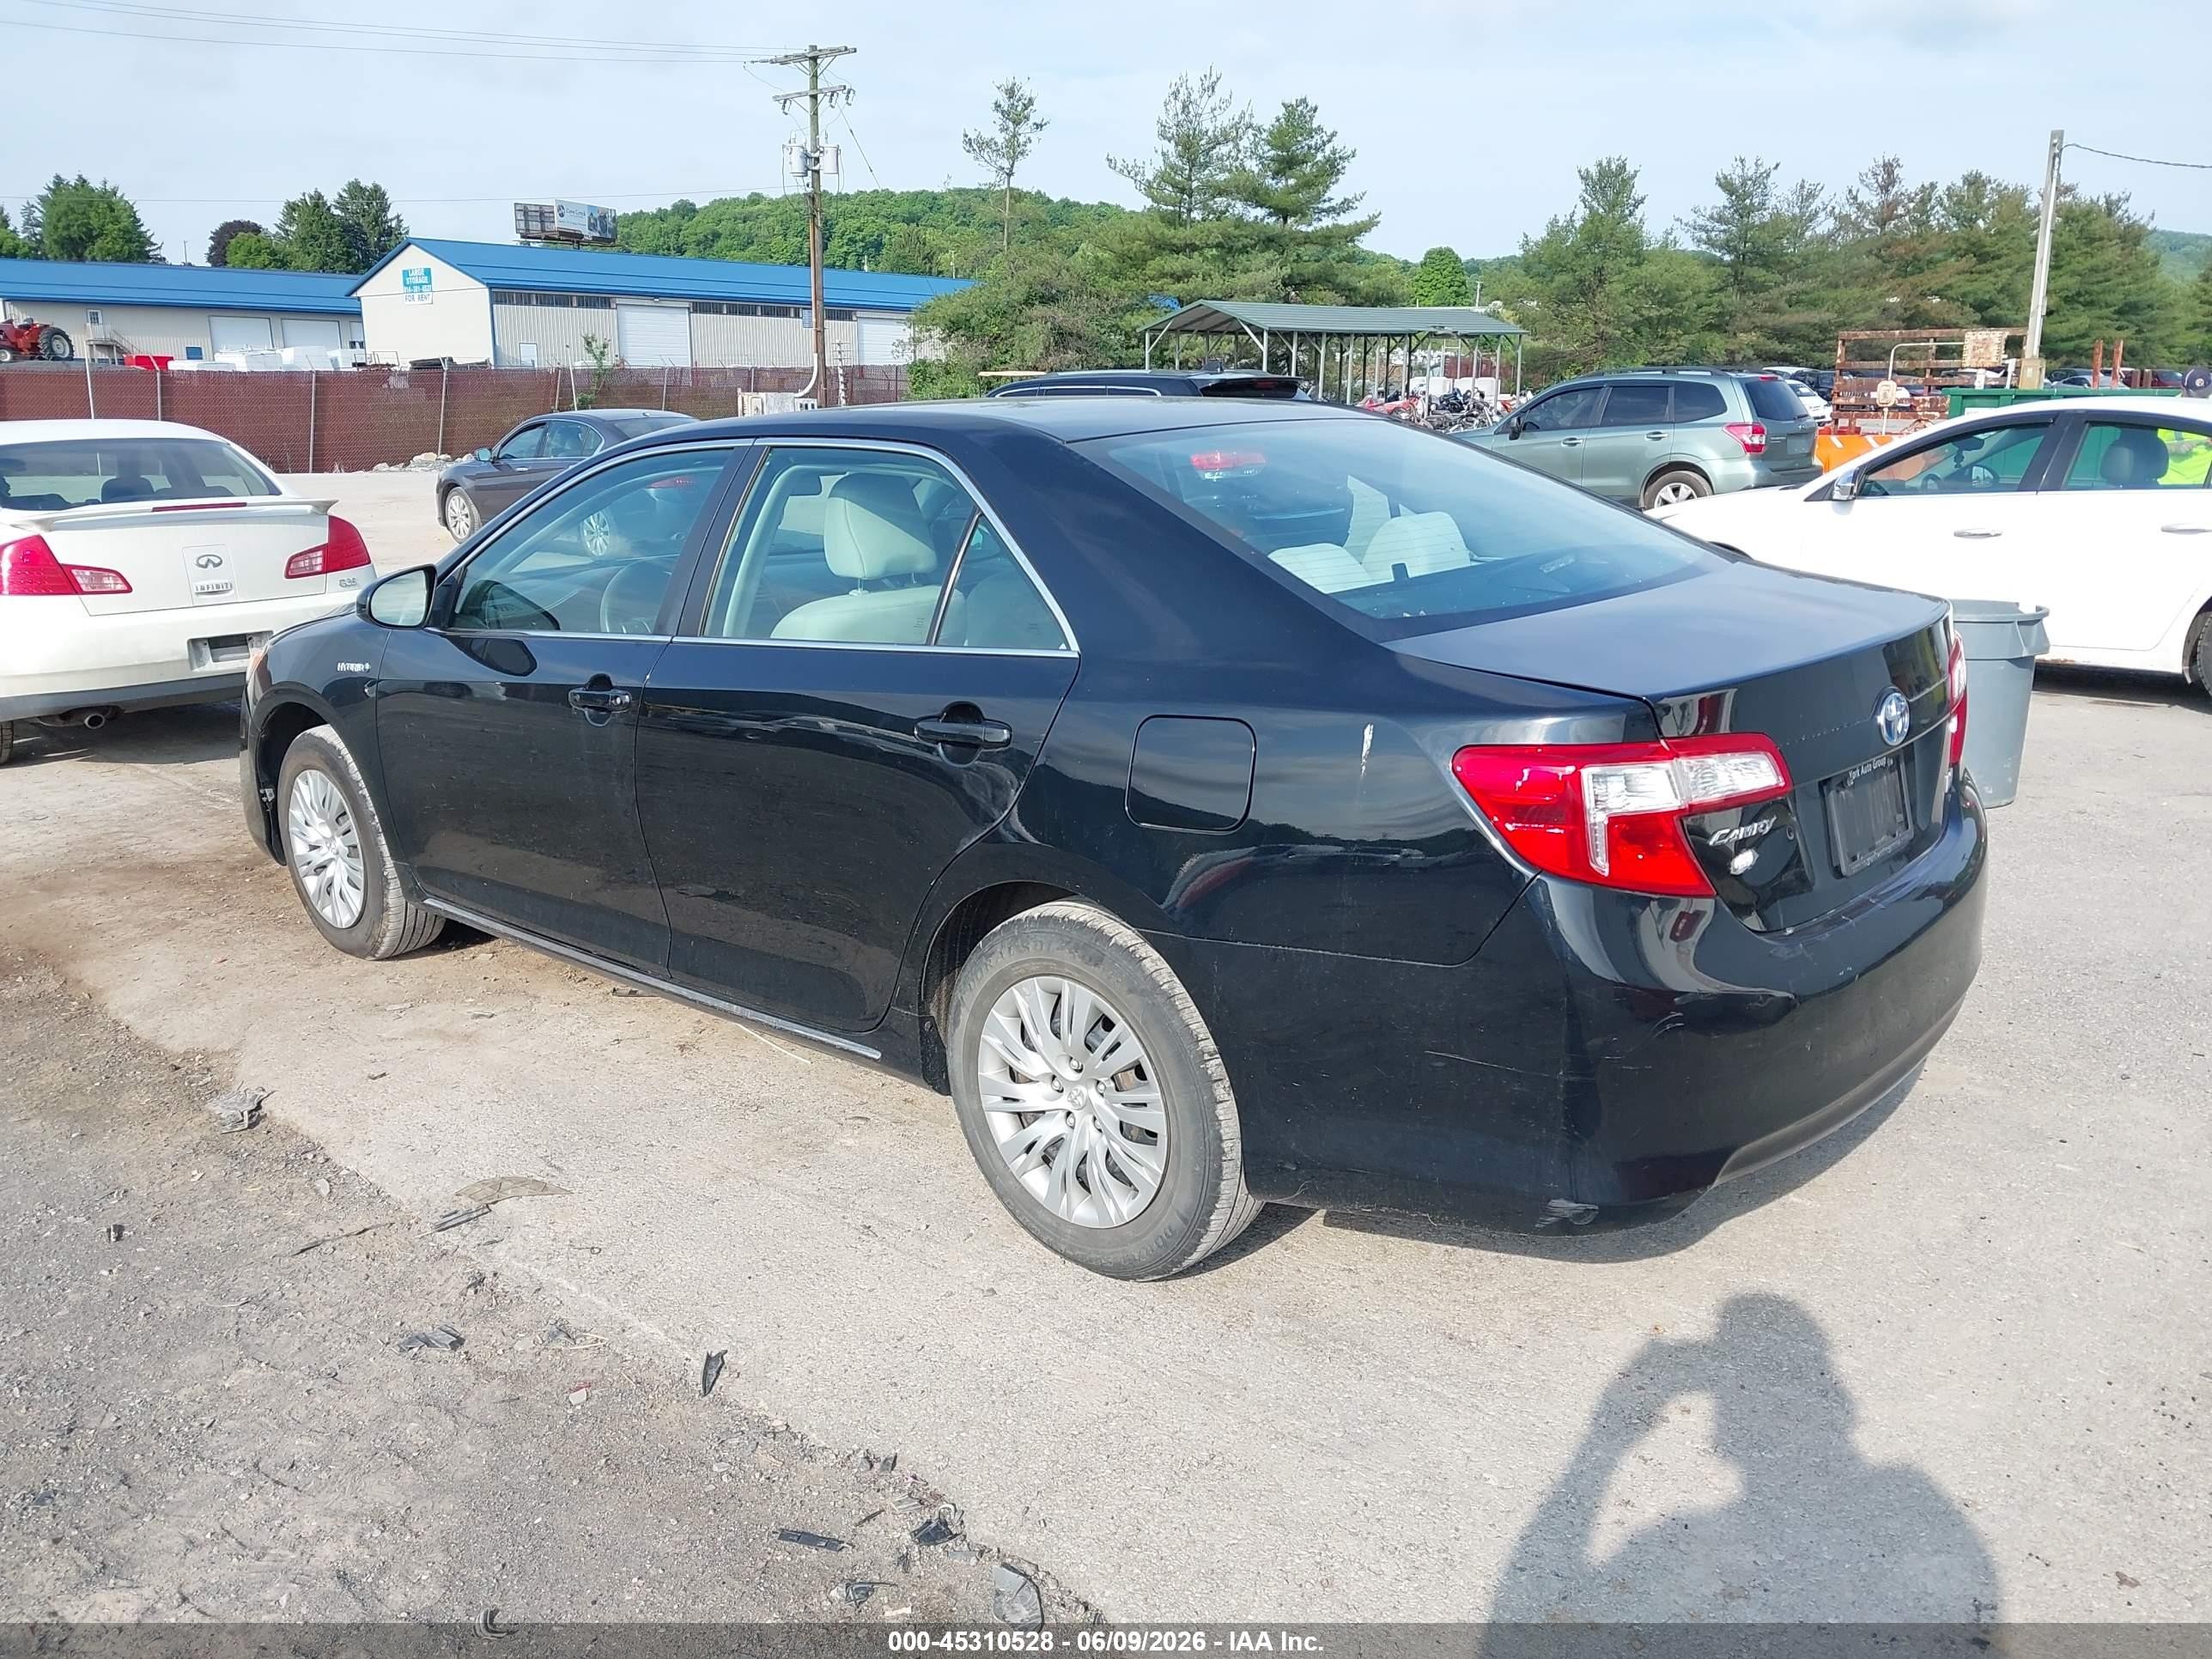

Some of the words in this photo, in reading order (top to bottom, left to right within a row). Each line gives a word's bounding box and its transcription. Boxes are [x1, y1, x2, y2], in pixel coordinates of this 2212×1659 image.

[195, 582, 234, 592] INFINITI
[1849, 767, 1860, 780] York
[1861, 763, 1872, 775] Auto
[1872, 757, 1887, 769] Group
[1708, 815, 1778, 846] CAMRY
